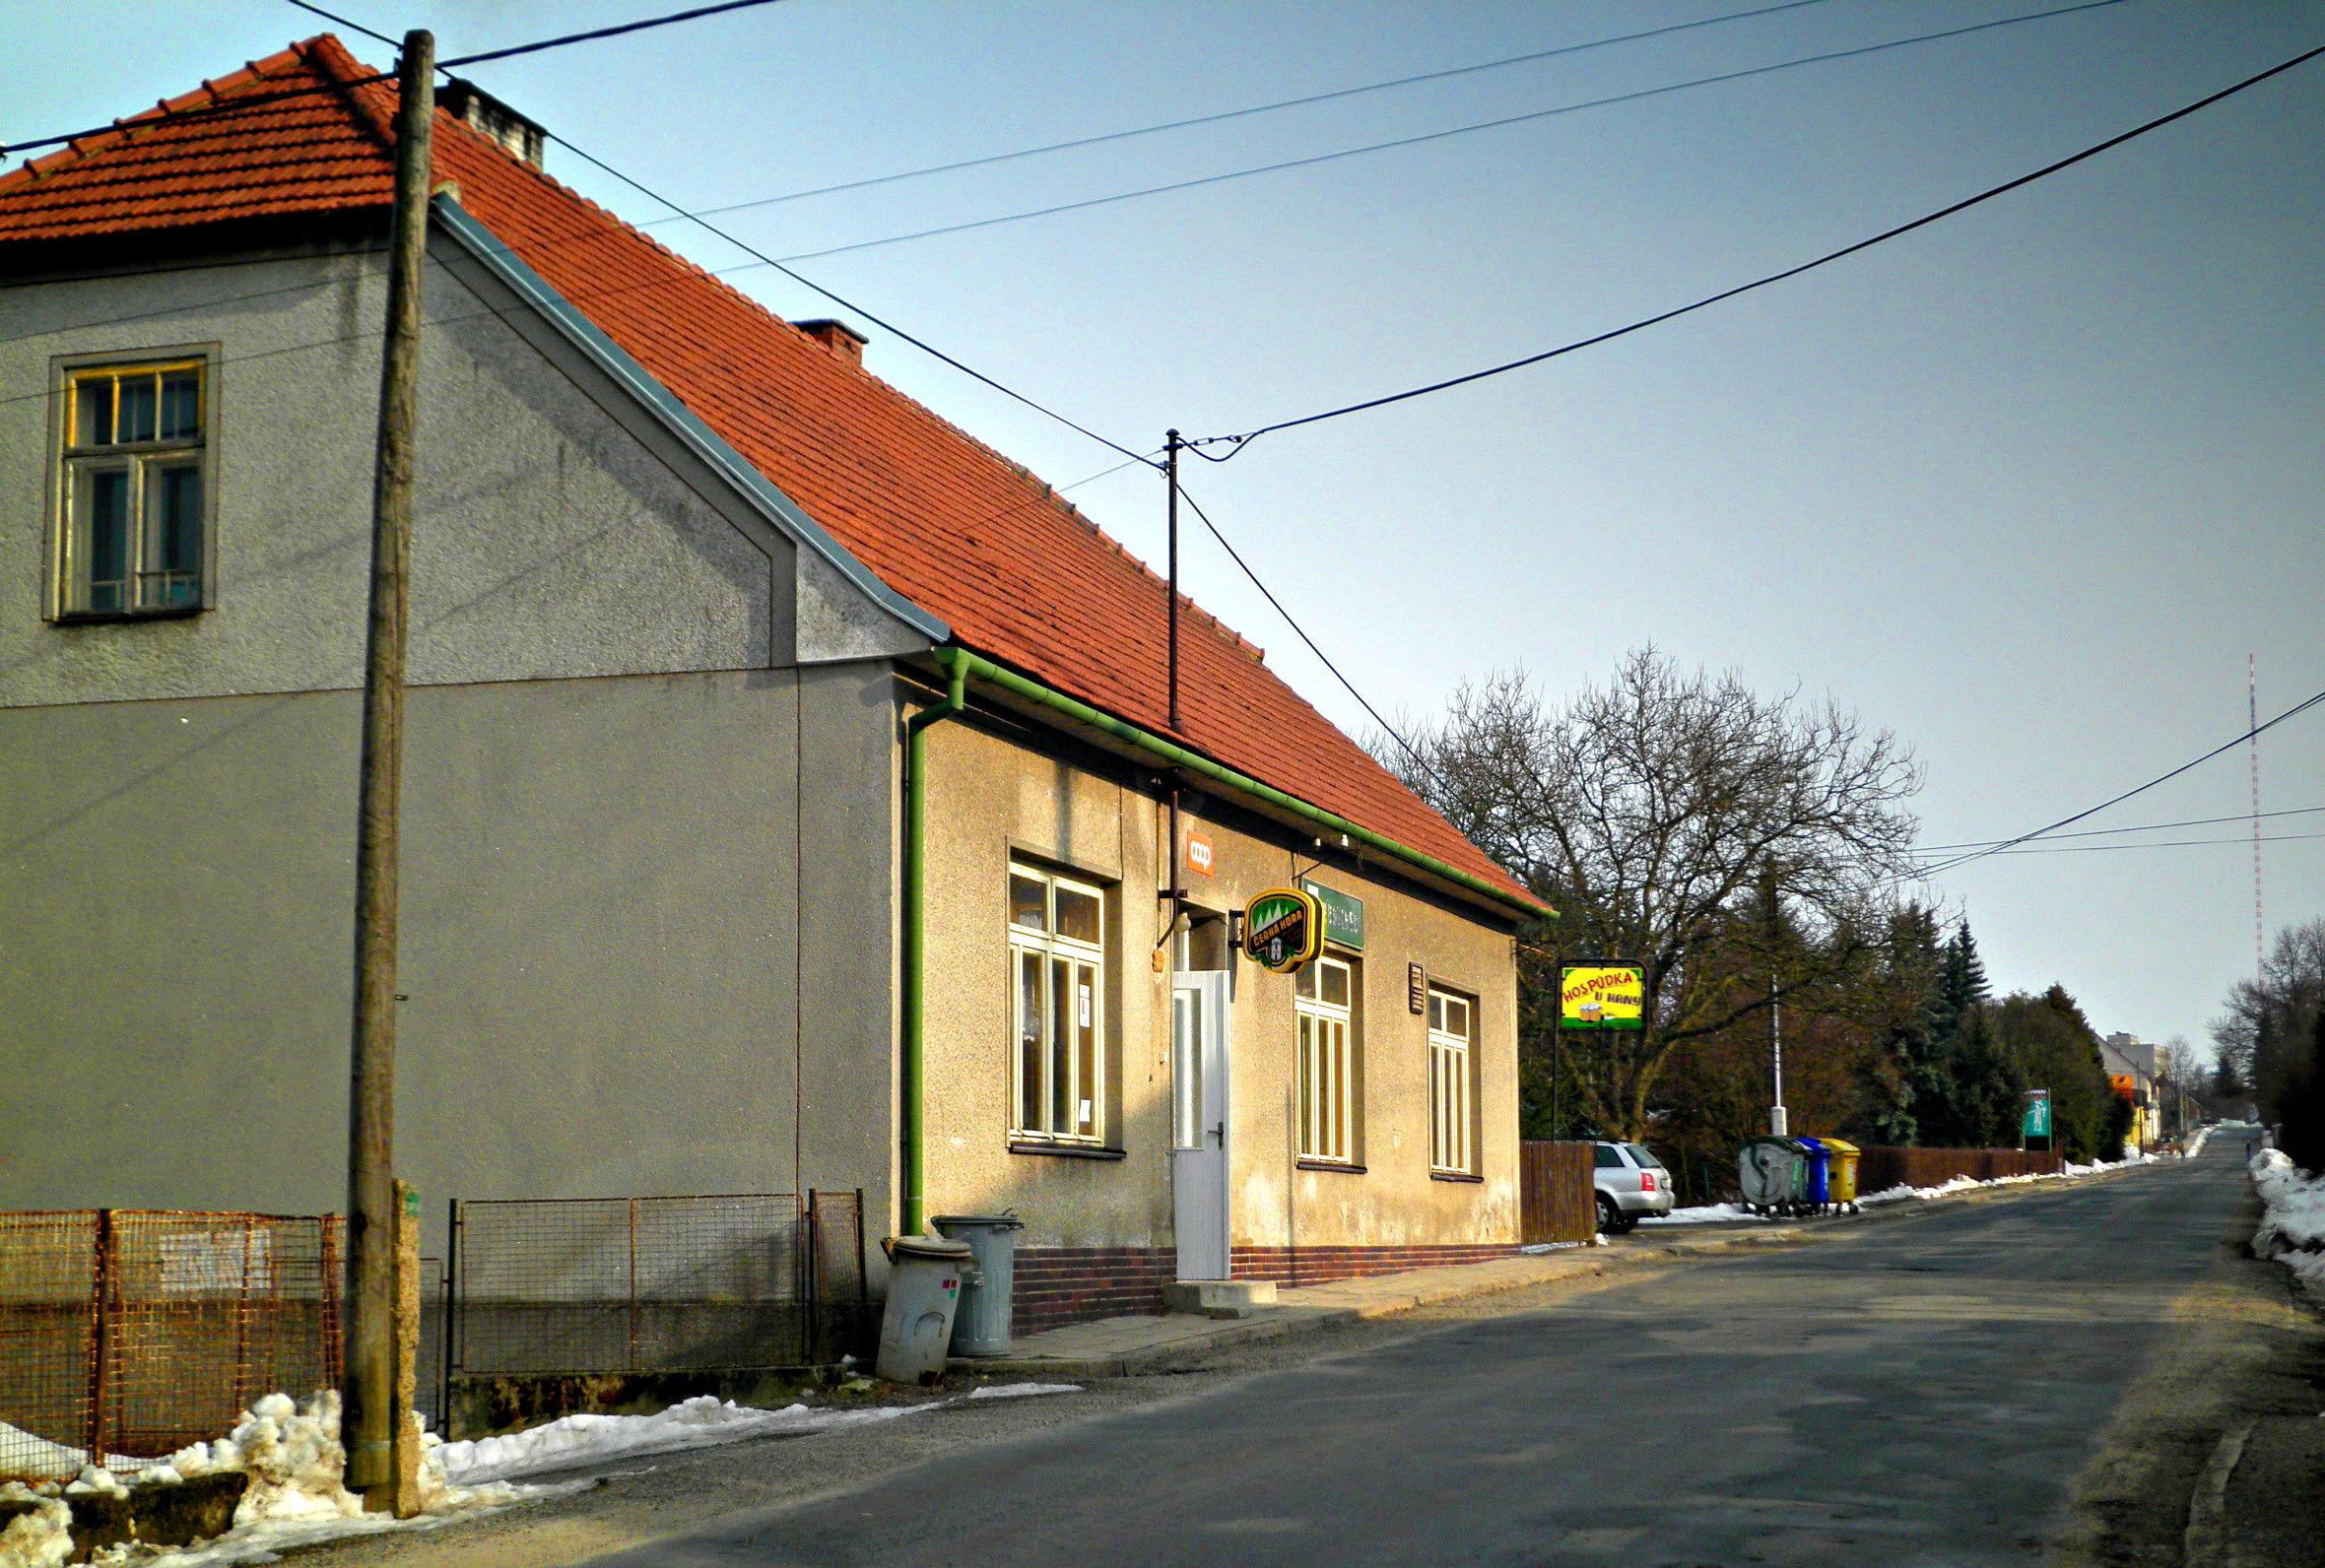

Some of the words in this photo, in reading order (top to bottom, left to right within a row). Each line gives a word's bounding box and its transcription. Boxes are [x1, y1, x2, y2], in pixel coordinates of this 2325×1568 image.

[1190, 840, 1211, 870] coop
[1280, 909, 1302, 930] HORA
[1594, 991, 1603, 1002] U
